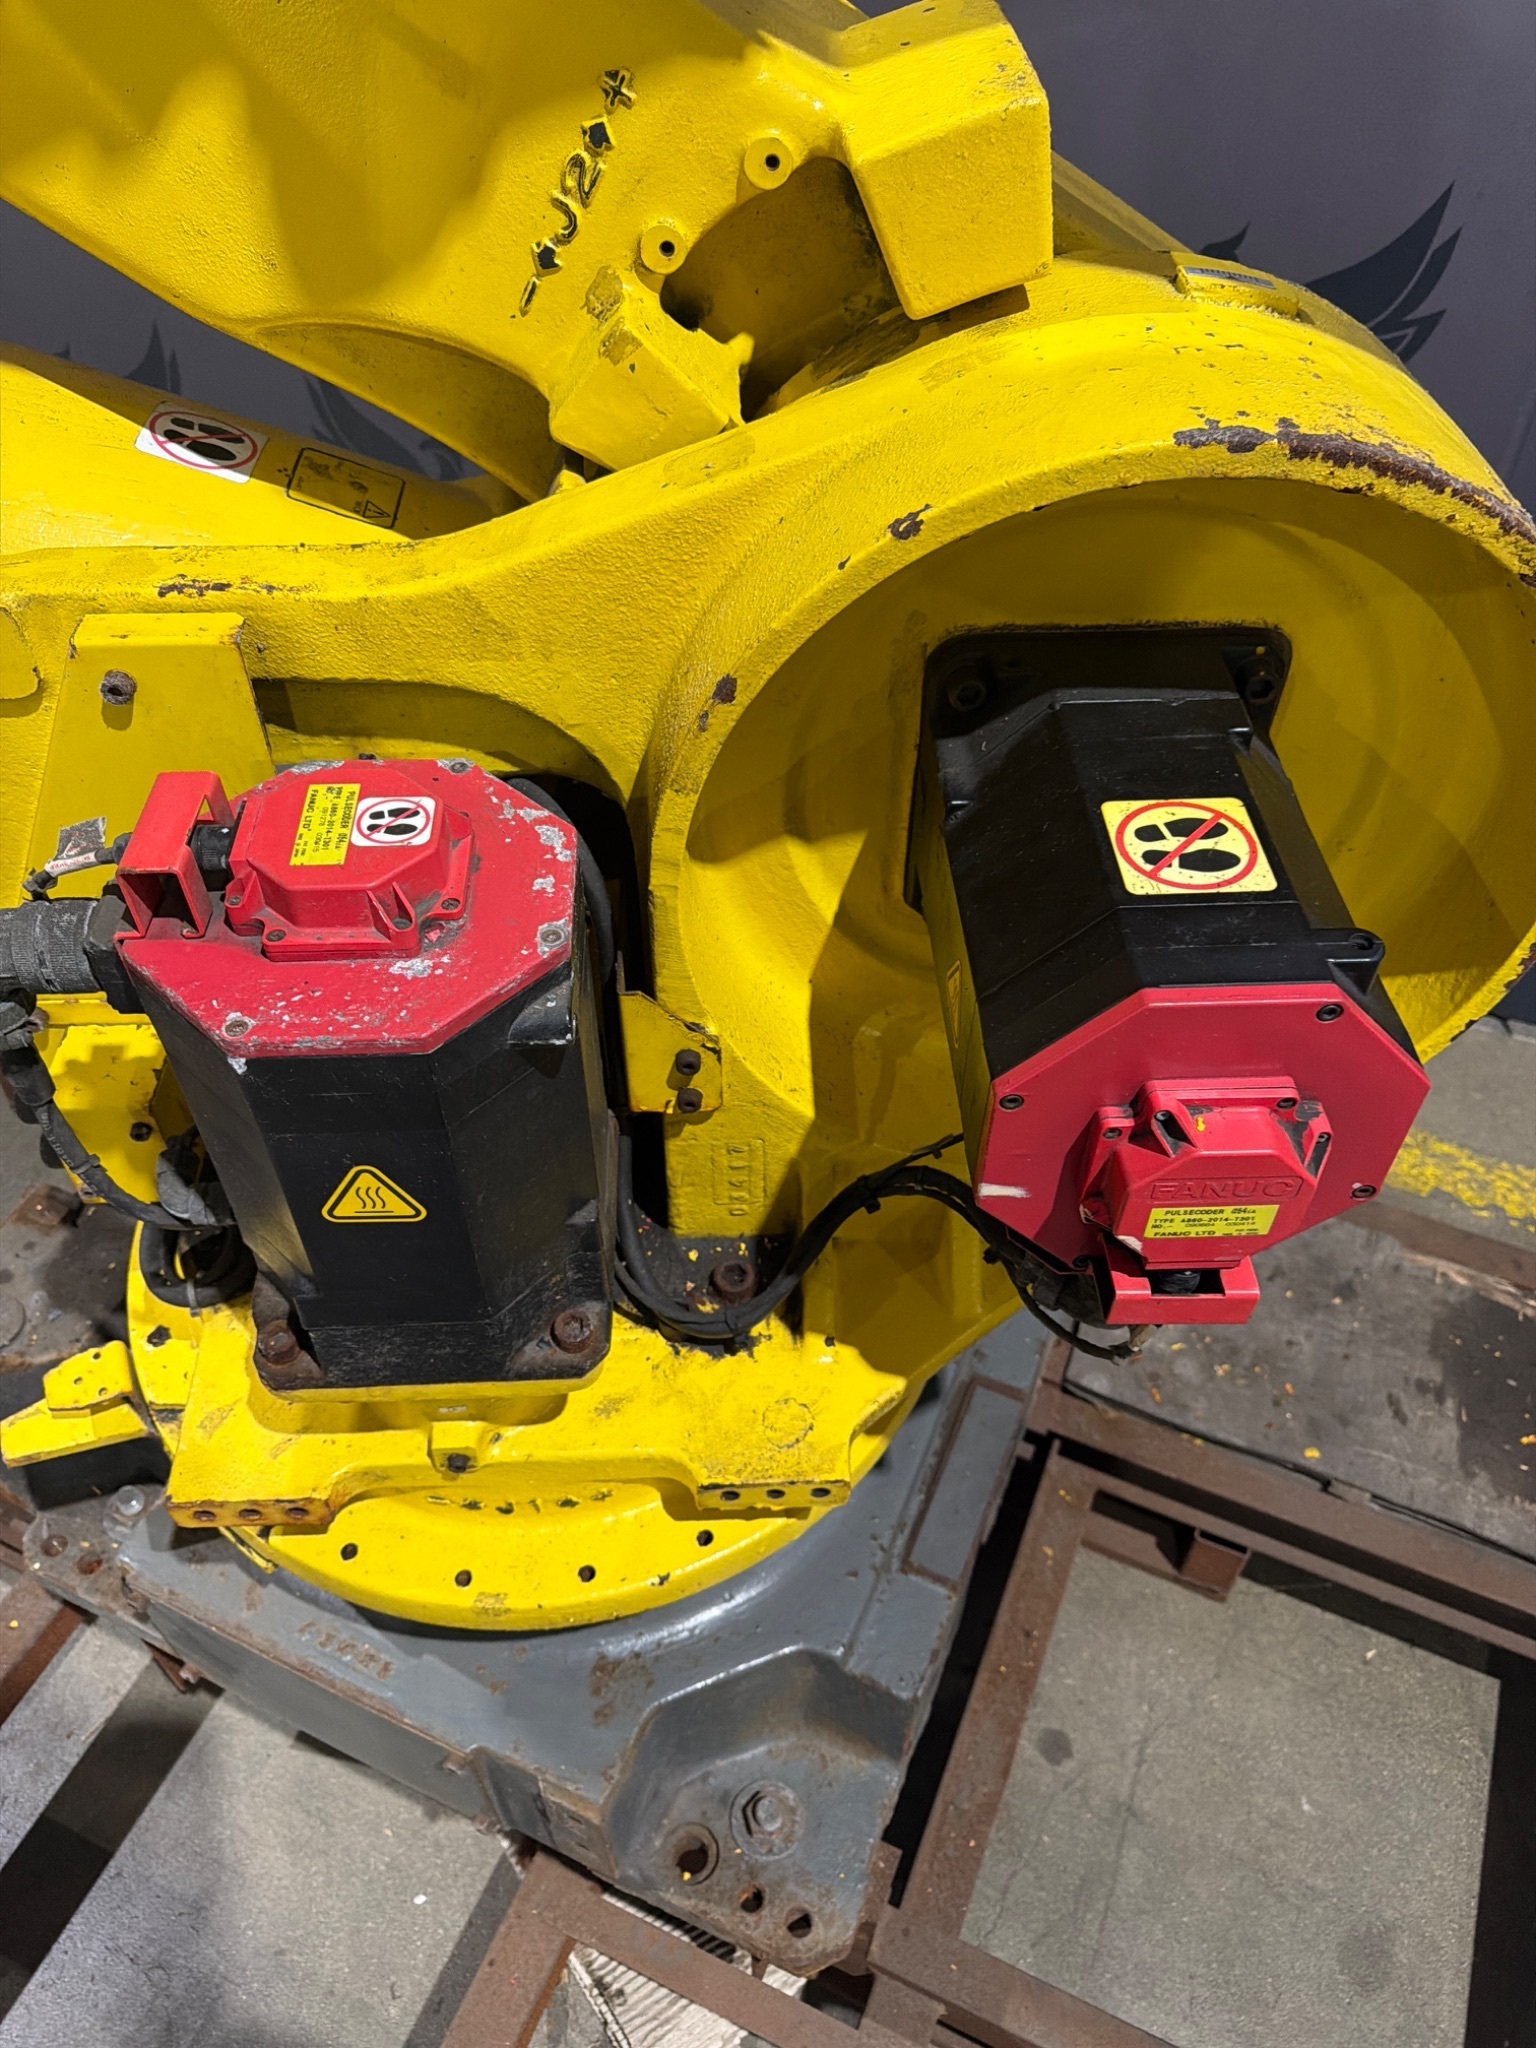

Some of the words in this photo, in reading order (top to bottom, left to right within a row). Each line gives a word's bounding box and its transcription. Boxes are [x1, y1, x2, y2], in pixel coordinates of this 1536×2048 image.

[306, 789, 319, 813] FANUC
[339, 791, 356, 829] PULSECODER
[1150, 1180, 1294, 1199] FANUC
[1164, 1208, 1224, 1216] PULSECODER
